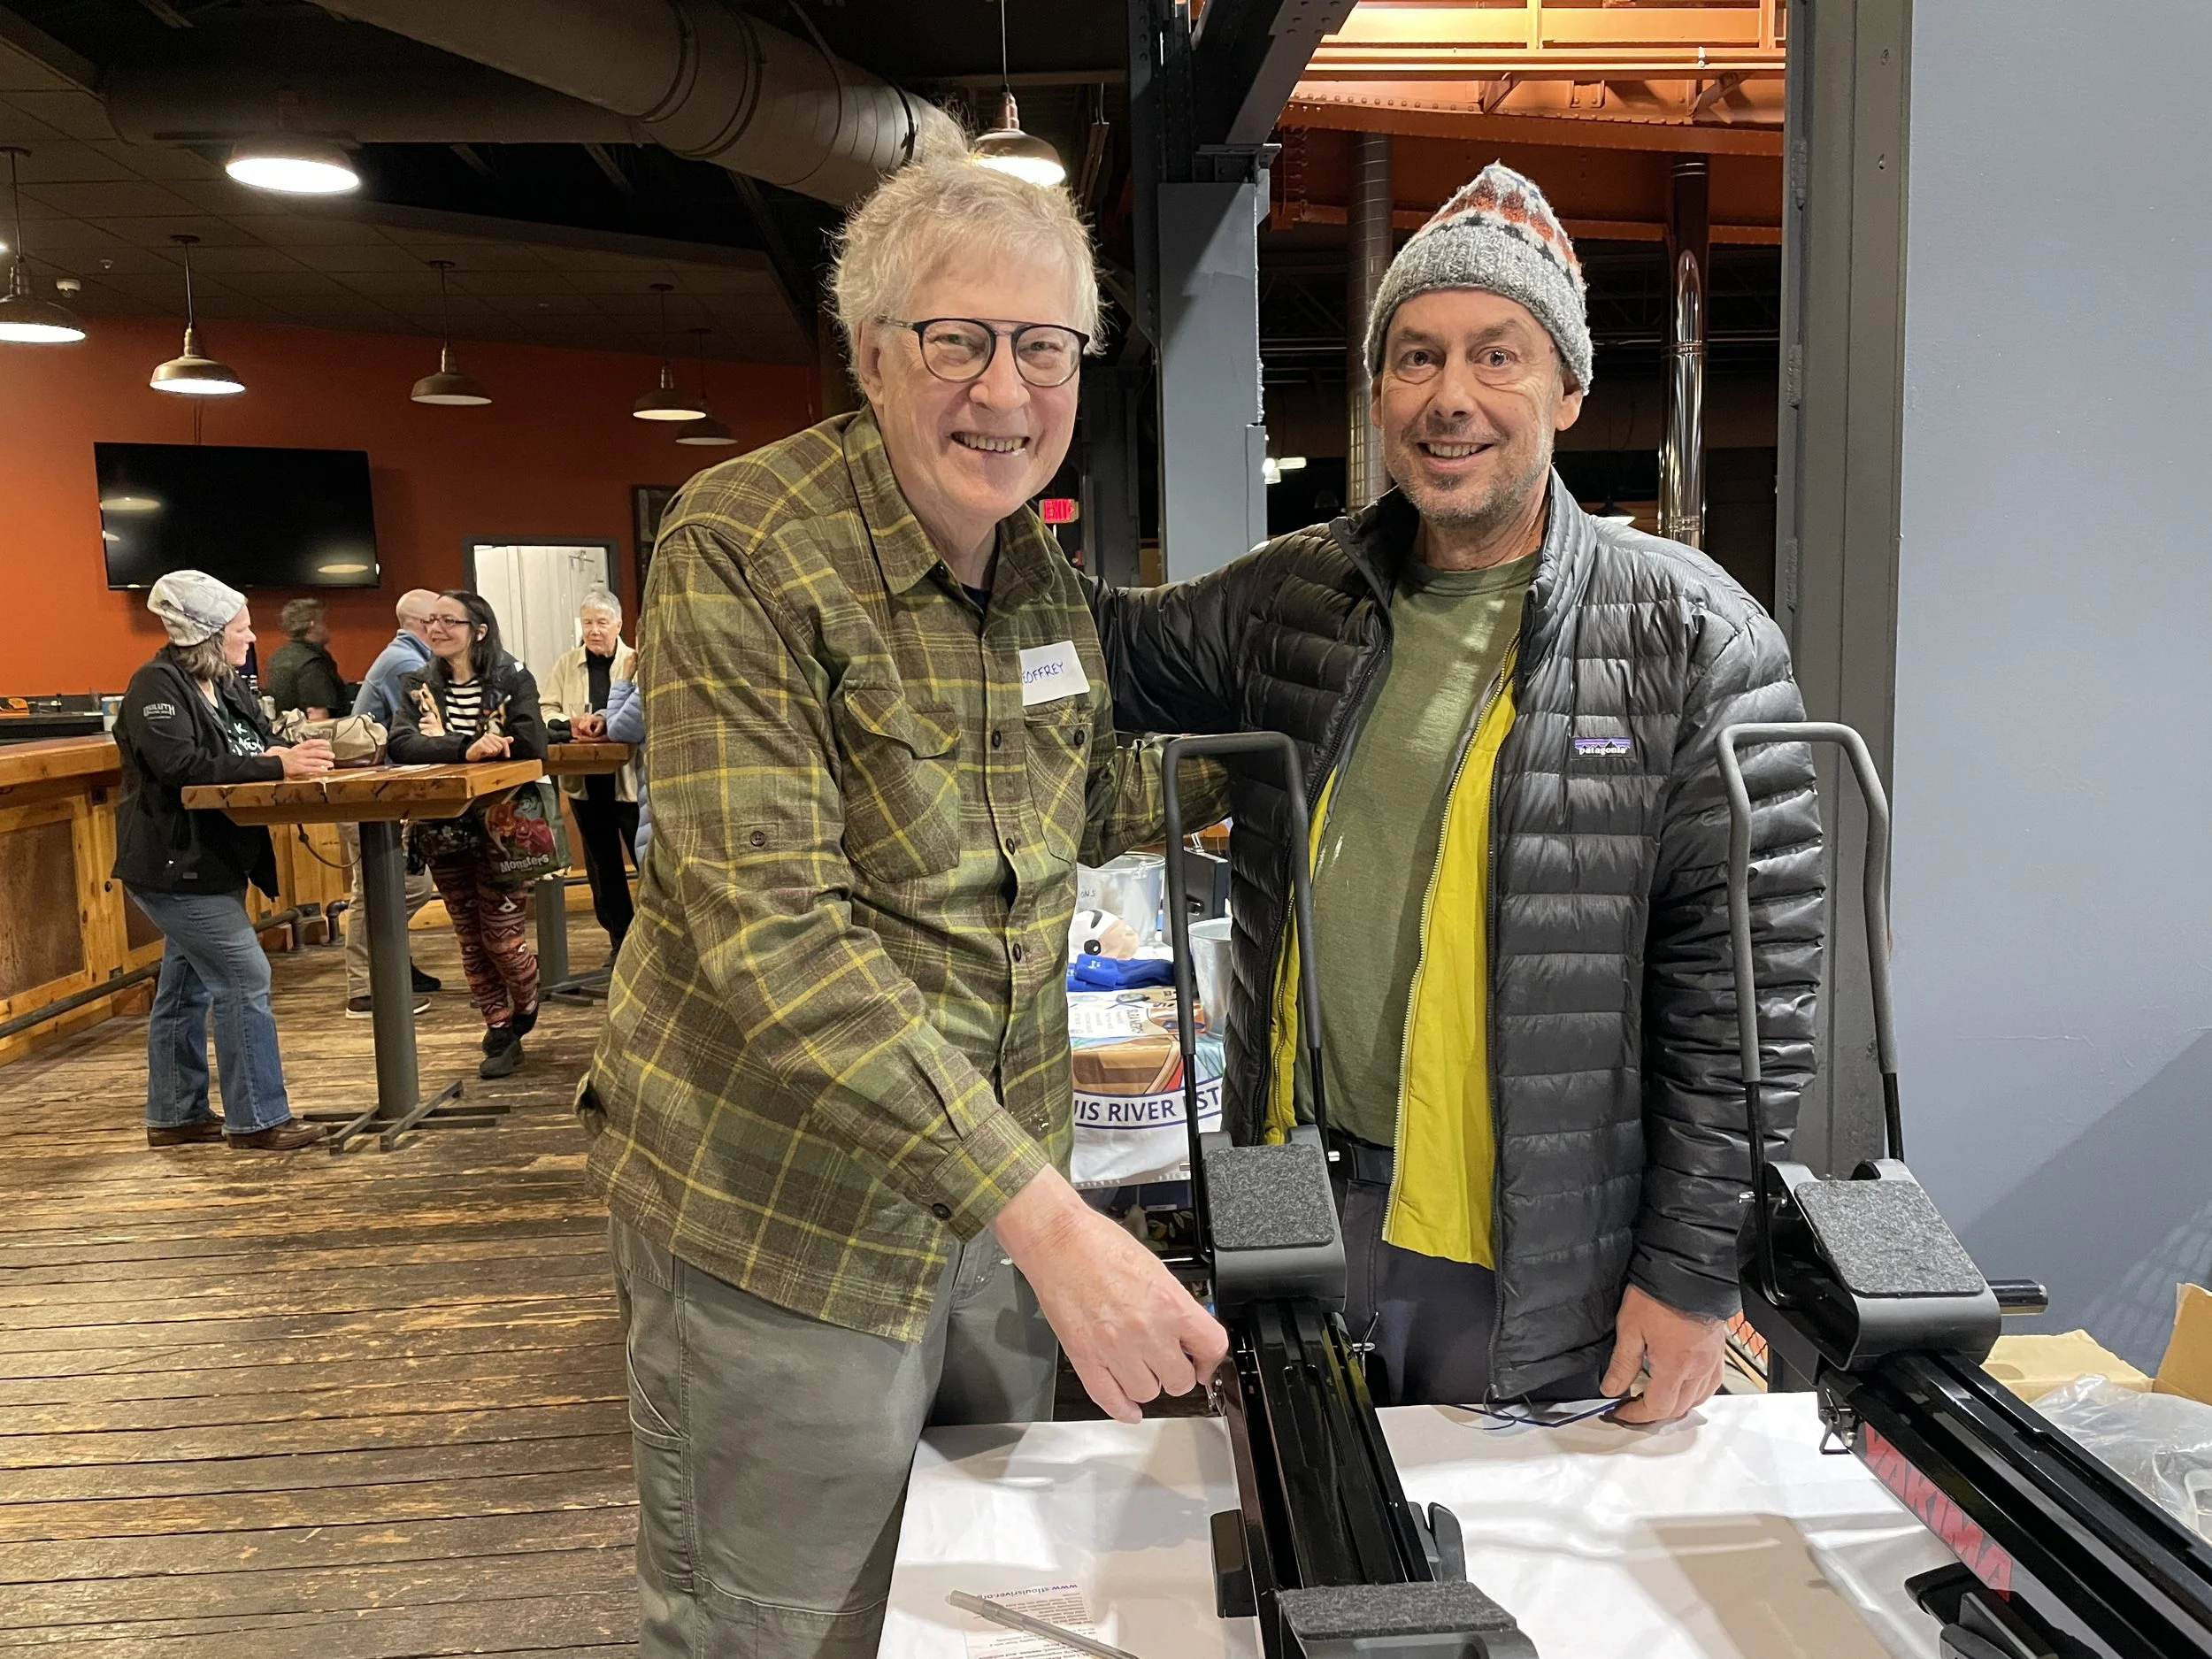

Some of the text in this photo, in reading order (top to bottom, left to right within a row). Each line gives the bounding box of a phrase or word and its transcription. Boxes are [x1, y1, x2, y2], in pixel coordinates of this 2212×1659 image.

[1045, 500, 1071, 520] EXIT
[1578, 747, 1627, 756] patagonia
[499, 854, 549, 873] Monsters
[1108, 1099, 1177, 1122] RIVER
[1863, 1421, 2012, 1602] YAKIMA
